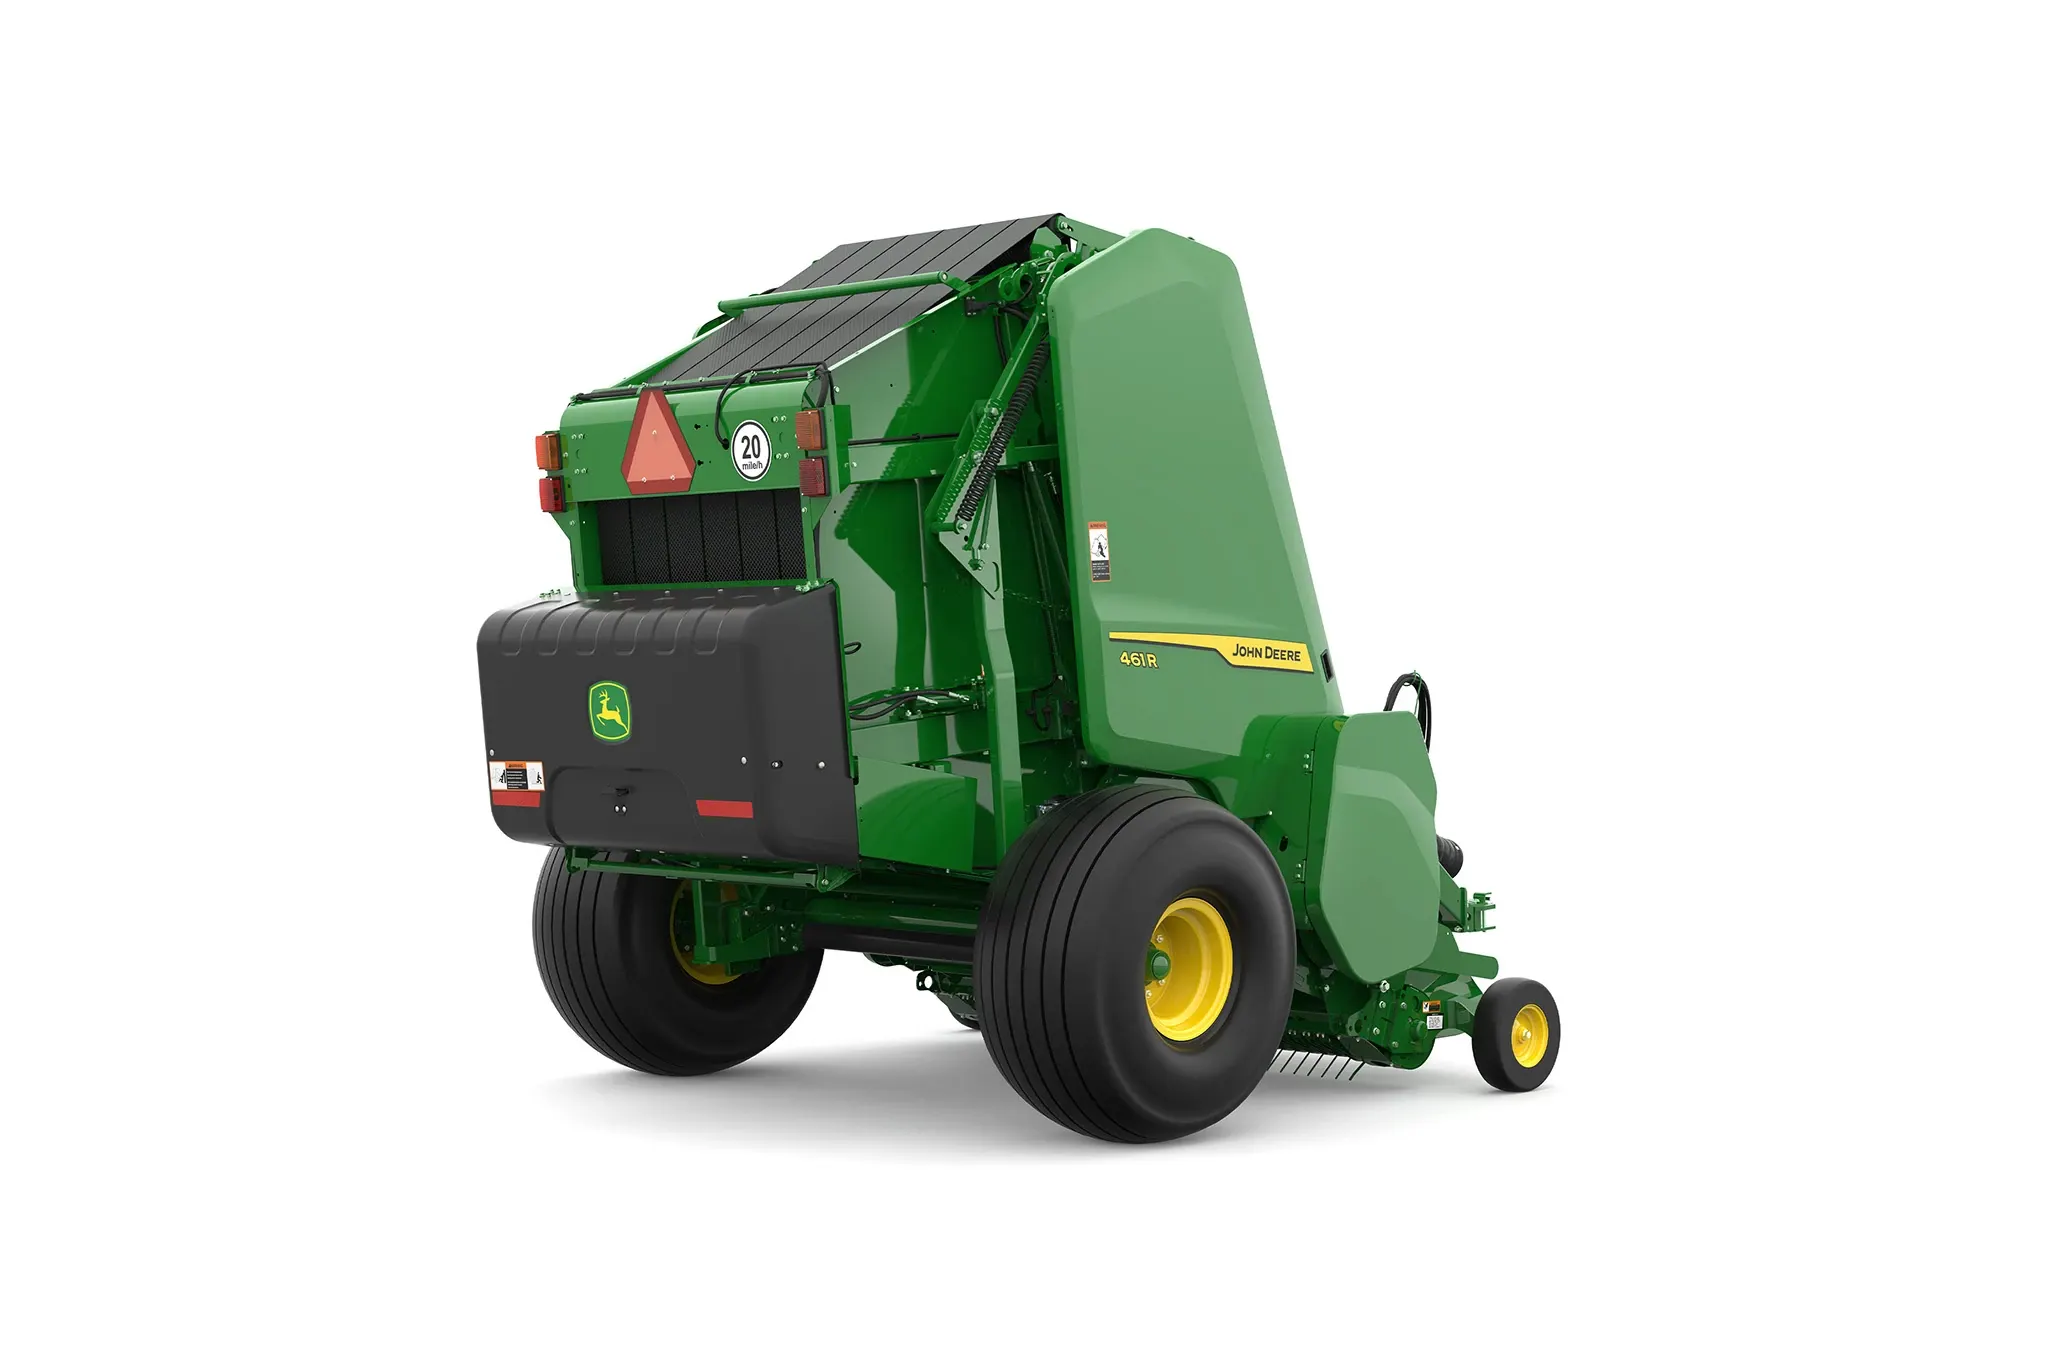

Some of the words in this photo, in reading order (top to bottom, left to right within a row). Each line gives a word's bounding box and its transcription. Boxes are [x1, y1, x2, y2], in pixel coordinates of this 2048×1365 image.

[741, 435, 761, 459] 20
[742, 461, 763, 470] mile/h
[1232, 643, 1262, 658] JOHN
[1265, 646, 1301, 661] DEERE
